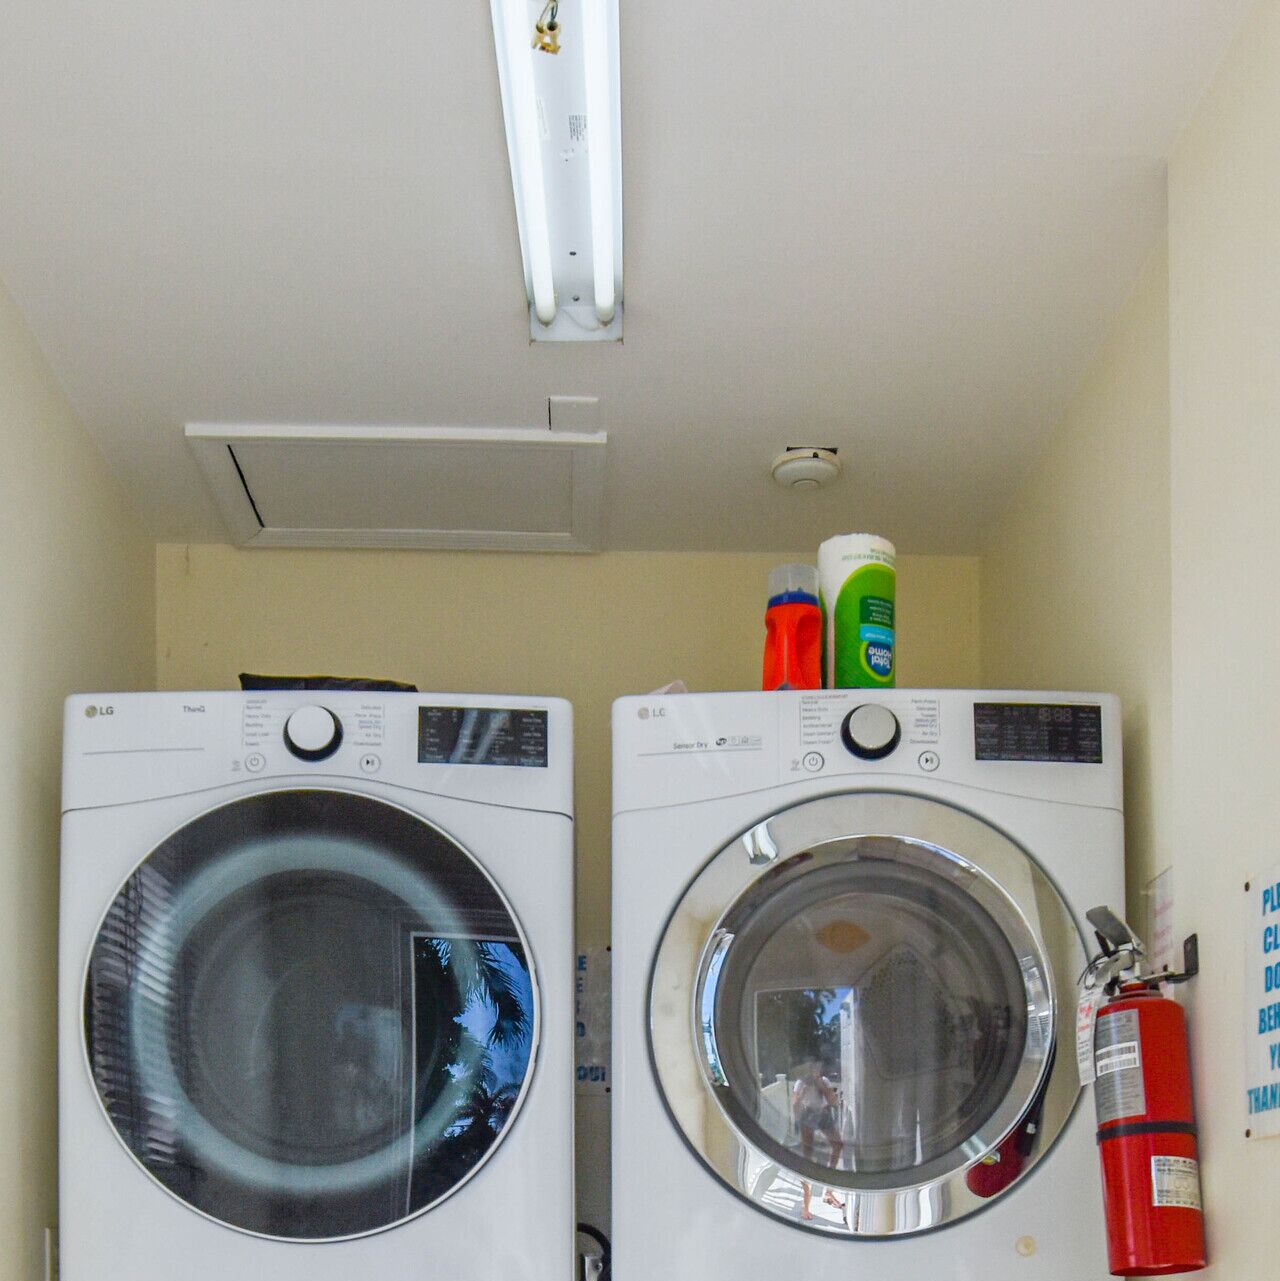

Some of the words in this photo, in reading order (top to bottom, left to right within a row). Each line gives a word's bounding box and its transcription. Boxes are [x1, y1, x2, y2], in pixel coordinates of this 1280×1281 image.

[871, 655, 891, 669] Total
[99, 706, 114, 716] LG
[577, 1065, 606, 1082] OU!
